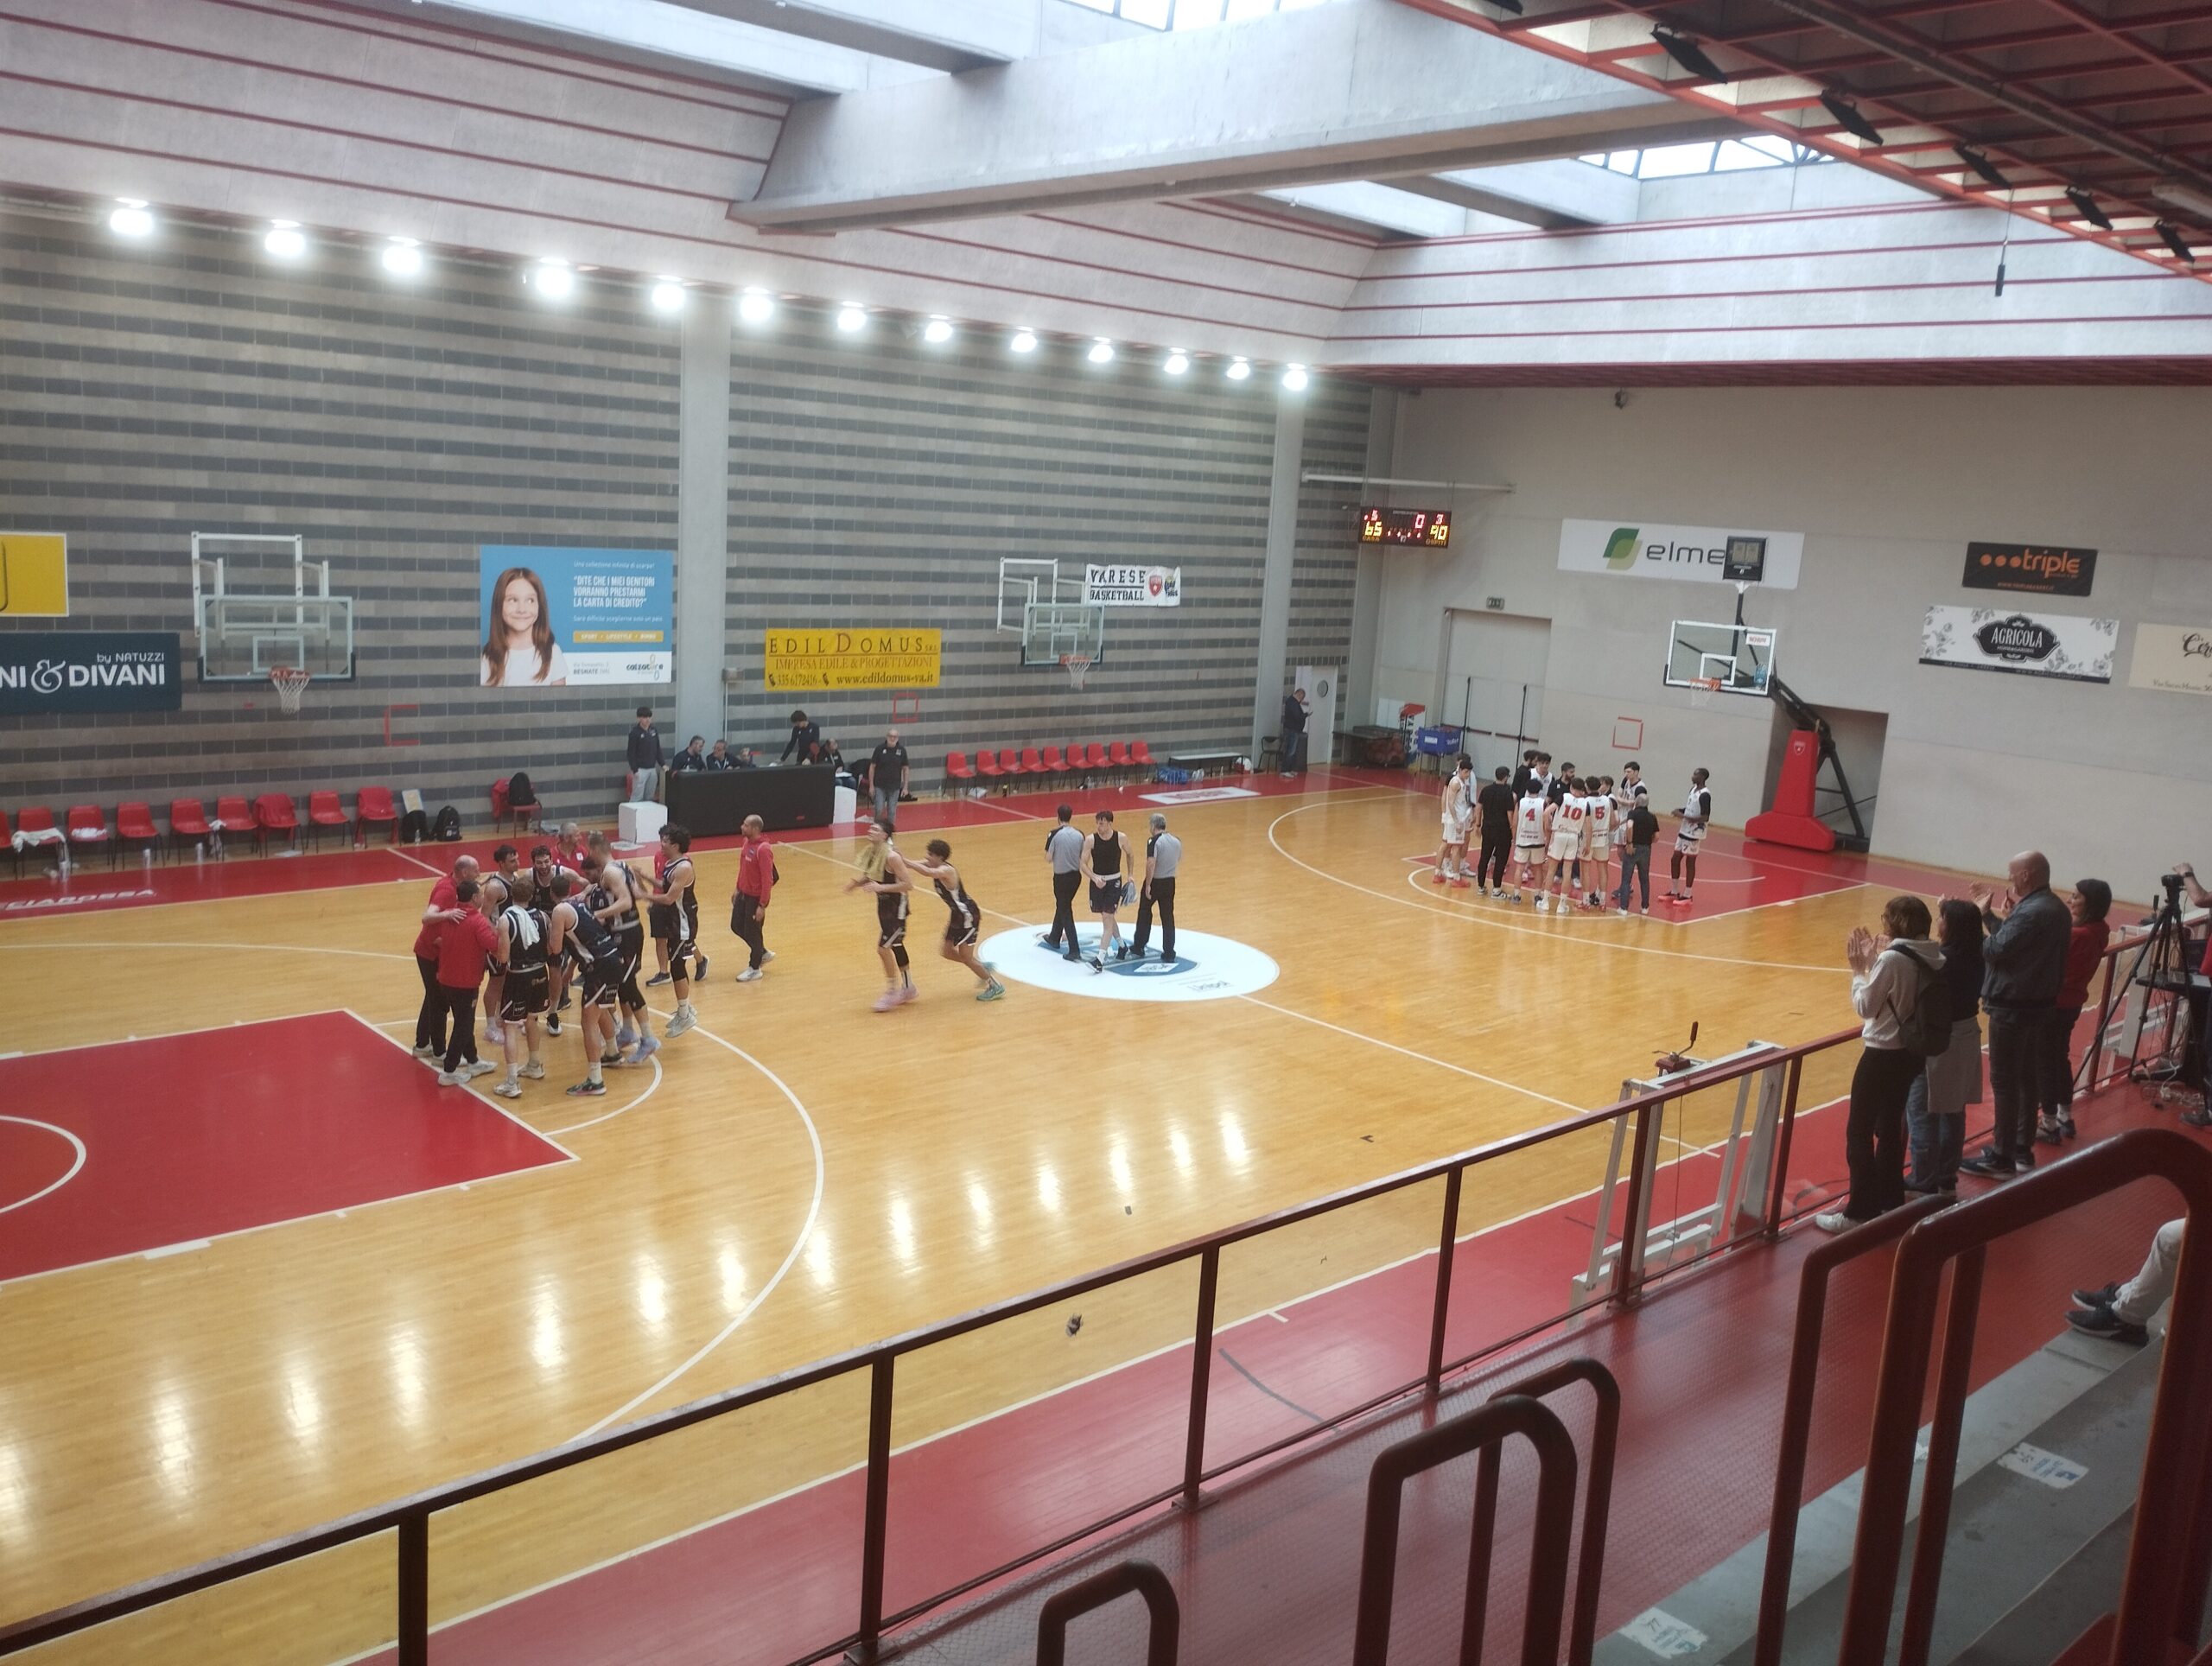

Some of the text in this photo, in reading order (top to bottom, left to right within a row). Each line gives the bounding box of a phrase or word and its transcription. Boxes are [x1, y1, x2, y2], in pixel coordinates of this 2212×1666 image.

[1415, 514, 1425, 528] 0
[1365, 521, 1448, 540] 65 90
[1646, 541, 1727, 564] elme
[2023, 548, 2081, 578] triple
[594, 575, 607, 587] CHE
[611, 576, 625, 587] MIEI
[626, 576, 655, 588] GENITORI
[1090, 569, 1147, 584] VARESE
[574, 586, 645, 598] VORRANNO PRESTARMI
[1090, 589, 1145, 601] BASKETBALL
[574, 597, 582, 607] LA
[583, 597, 604, 607] CARTA
[606, 597, 613, 608] DI
[1991, 626, 2043, 648] AGRICOLA
[97, 652, 165, 664] by NATUZZI
[775, 656, 932, 670] IMPRESA EDILE & PROGETTAZIONI
[30, 659, 67, 694] &
[68, 664, 166, 687] DIVANI
[836, 671, 933, 685] www.edildomus-va.it
[1525, 808, 1535, 821] 4
[1562, 804, 1583, 821] 10
